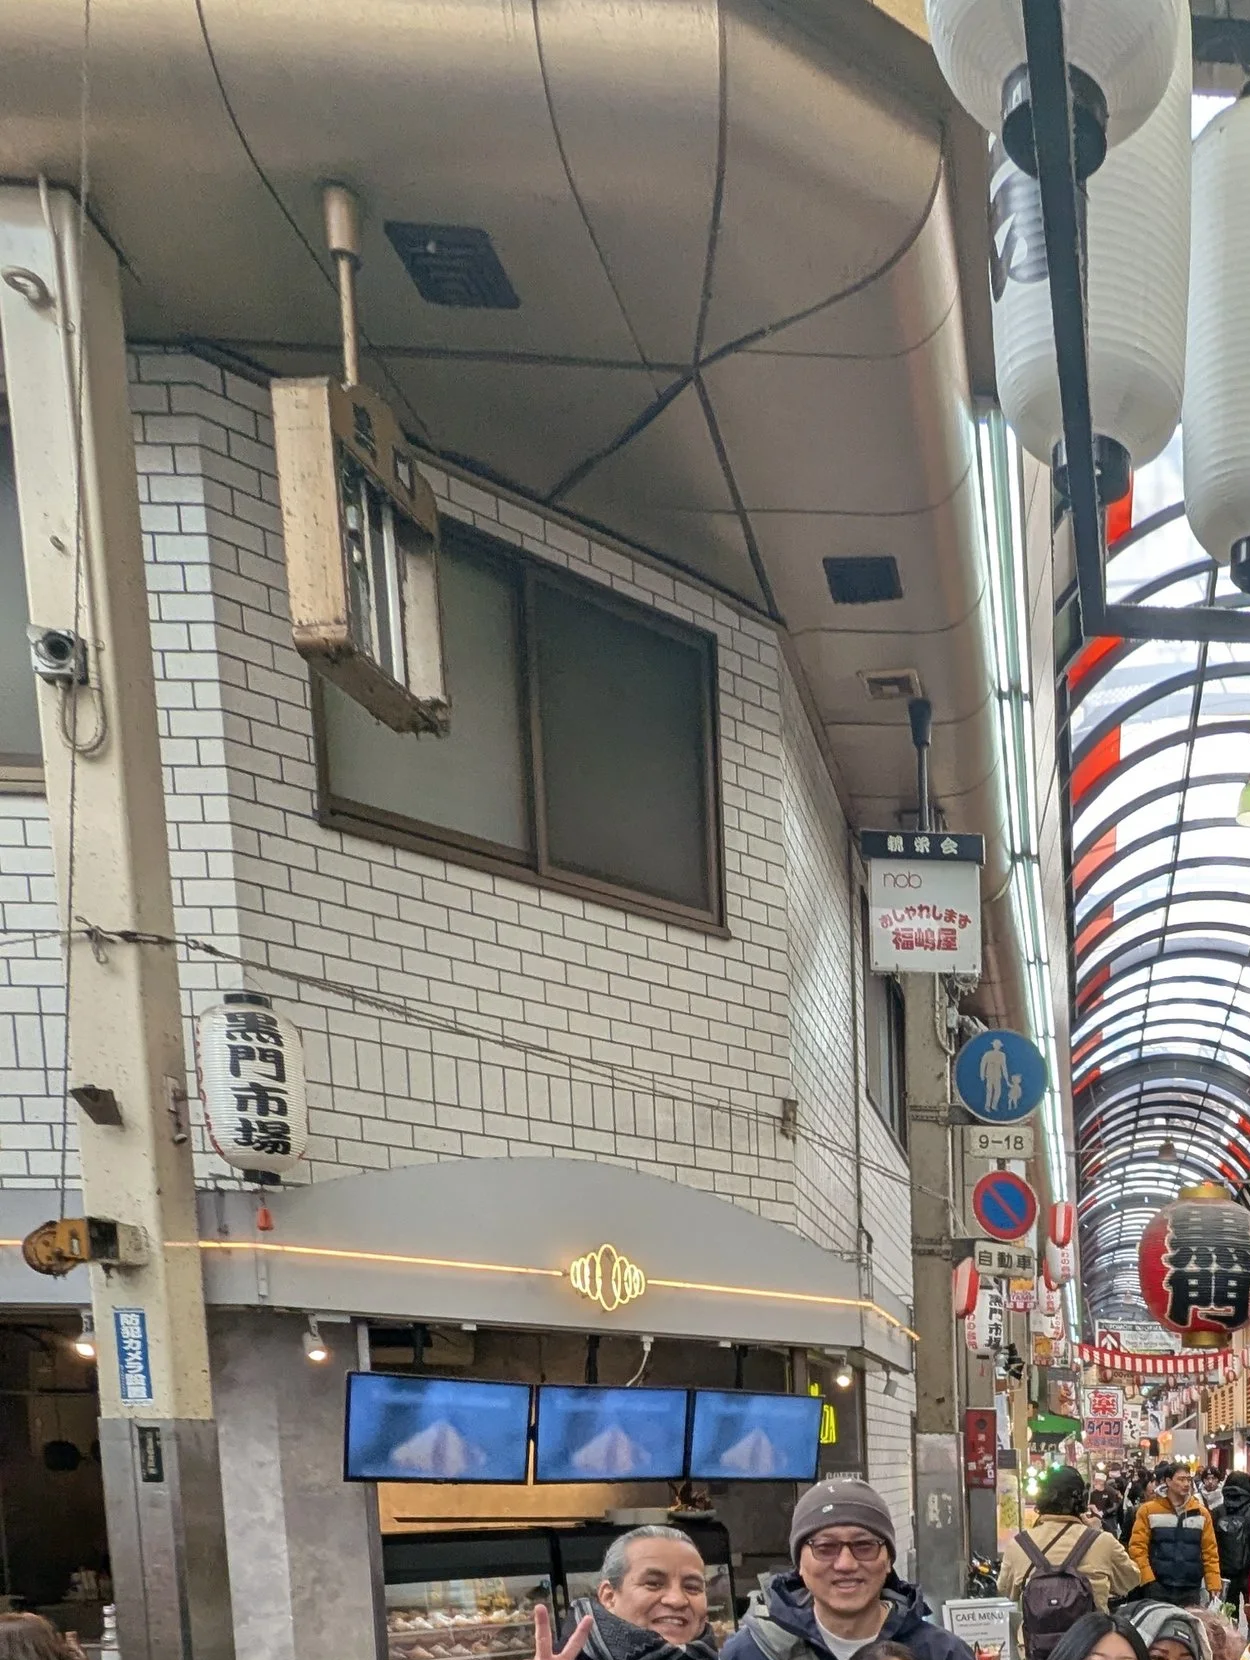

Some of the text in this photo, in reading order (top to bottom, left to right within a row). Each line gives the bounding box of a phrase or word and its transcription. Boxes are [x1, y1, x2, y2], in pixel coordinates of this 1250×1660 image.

[883, 871, 922, 889] nob
[879, 904, 971, 928] おしゃれします
[226, 1012, 291, 1155] 黒門市場
[978, 1135, 1024, 1150] 9-18
[979, 1251, 1032, 1270] 自動車
[1090, 1389, 1119, 1417] 薬
[1088, 1421, 1120, 1436] ダイコク
[956, 1611, 1004, 1621] CAFÉ MENU
